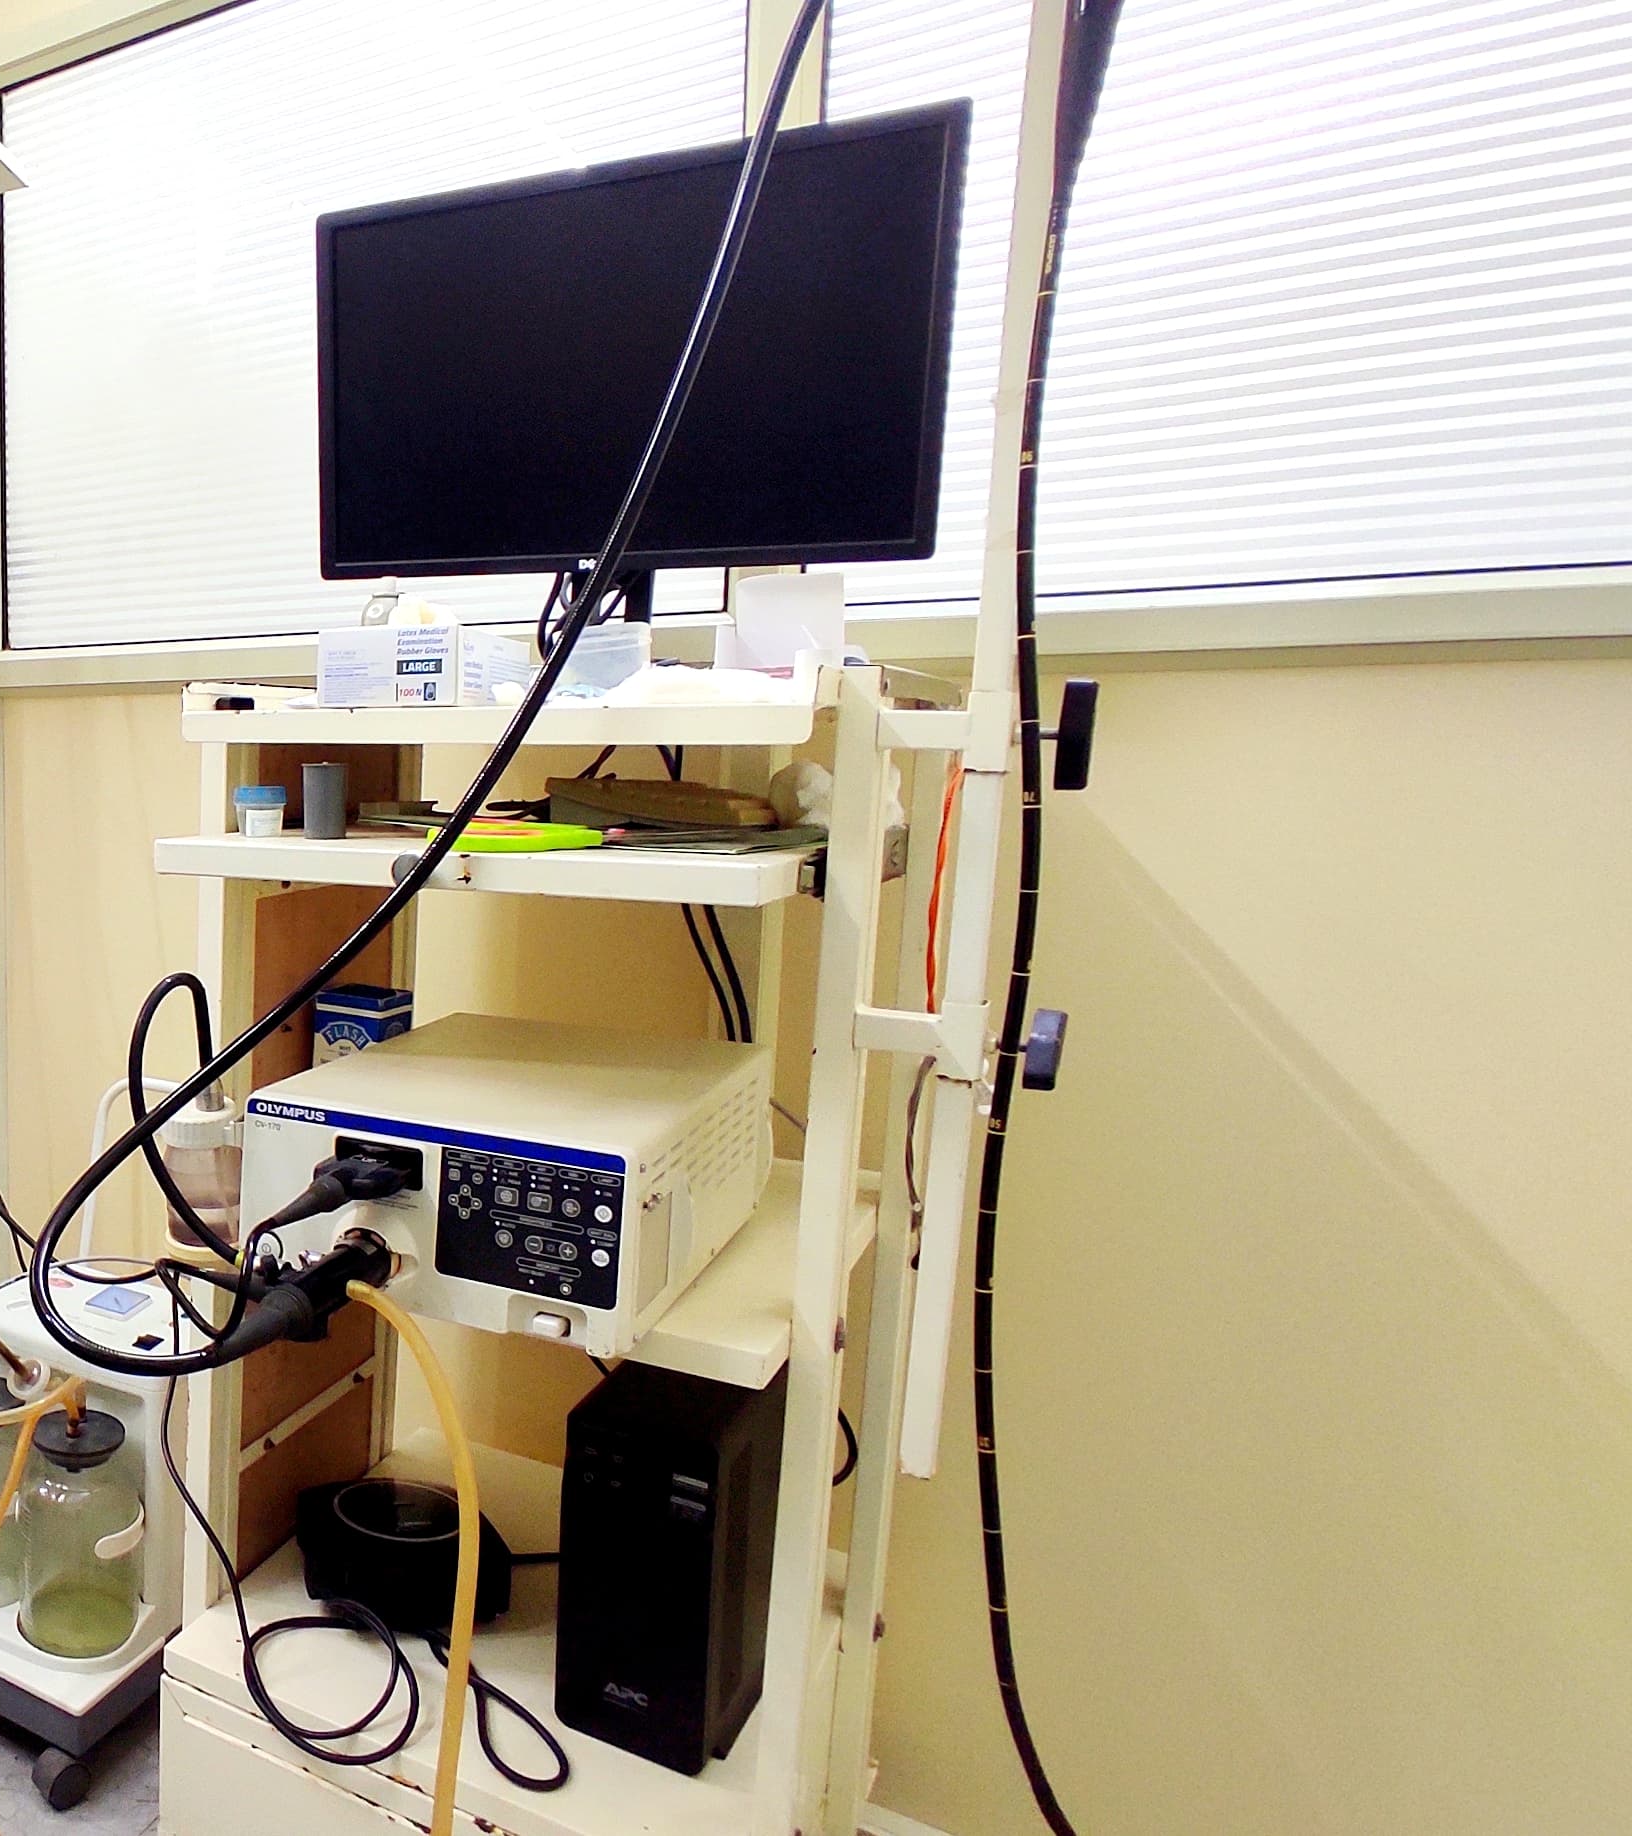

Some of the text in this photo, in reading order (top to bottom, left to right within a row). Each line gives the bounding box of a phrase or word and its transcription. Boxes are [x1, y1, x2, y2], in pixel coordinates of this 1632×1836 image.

[418, 626, 449, 635] Medical
[424, 646, 449, 654] Gloves
[402, 661, 436, 673] LARGE
[399, 688, 415, 697] 100
[325, 1024, 366, 1047] FLASH
[255, 1101, 326, 1122] OLYMPUS
[604, 1682, 649, 1707] APC
